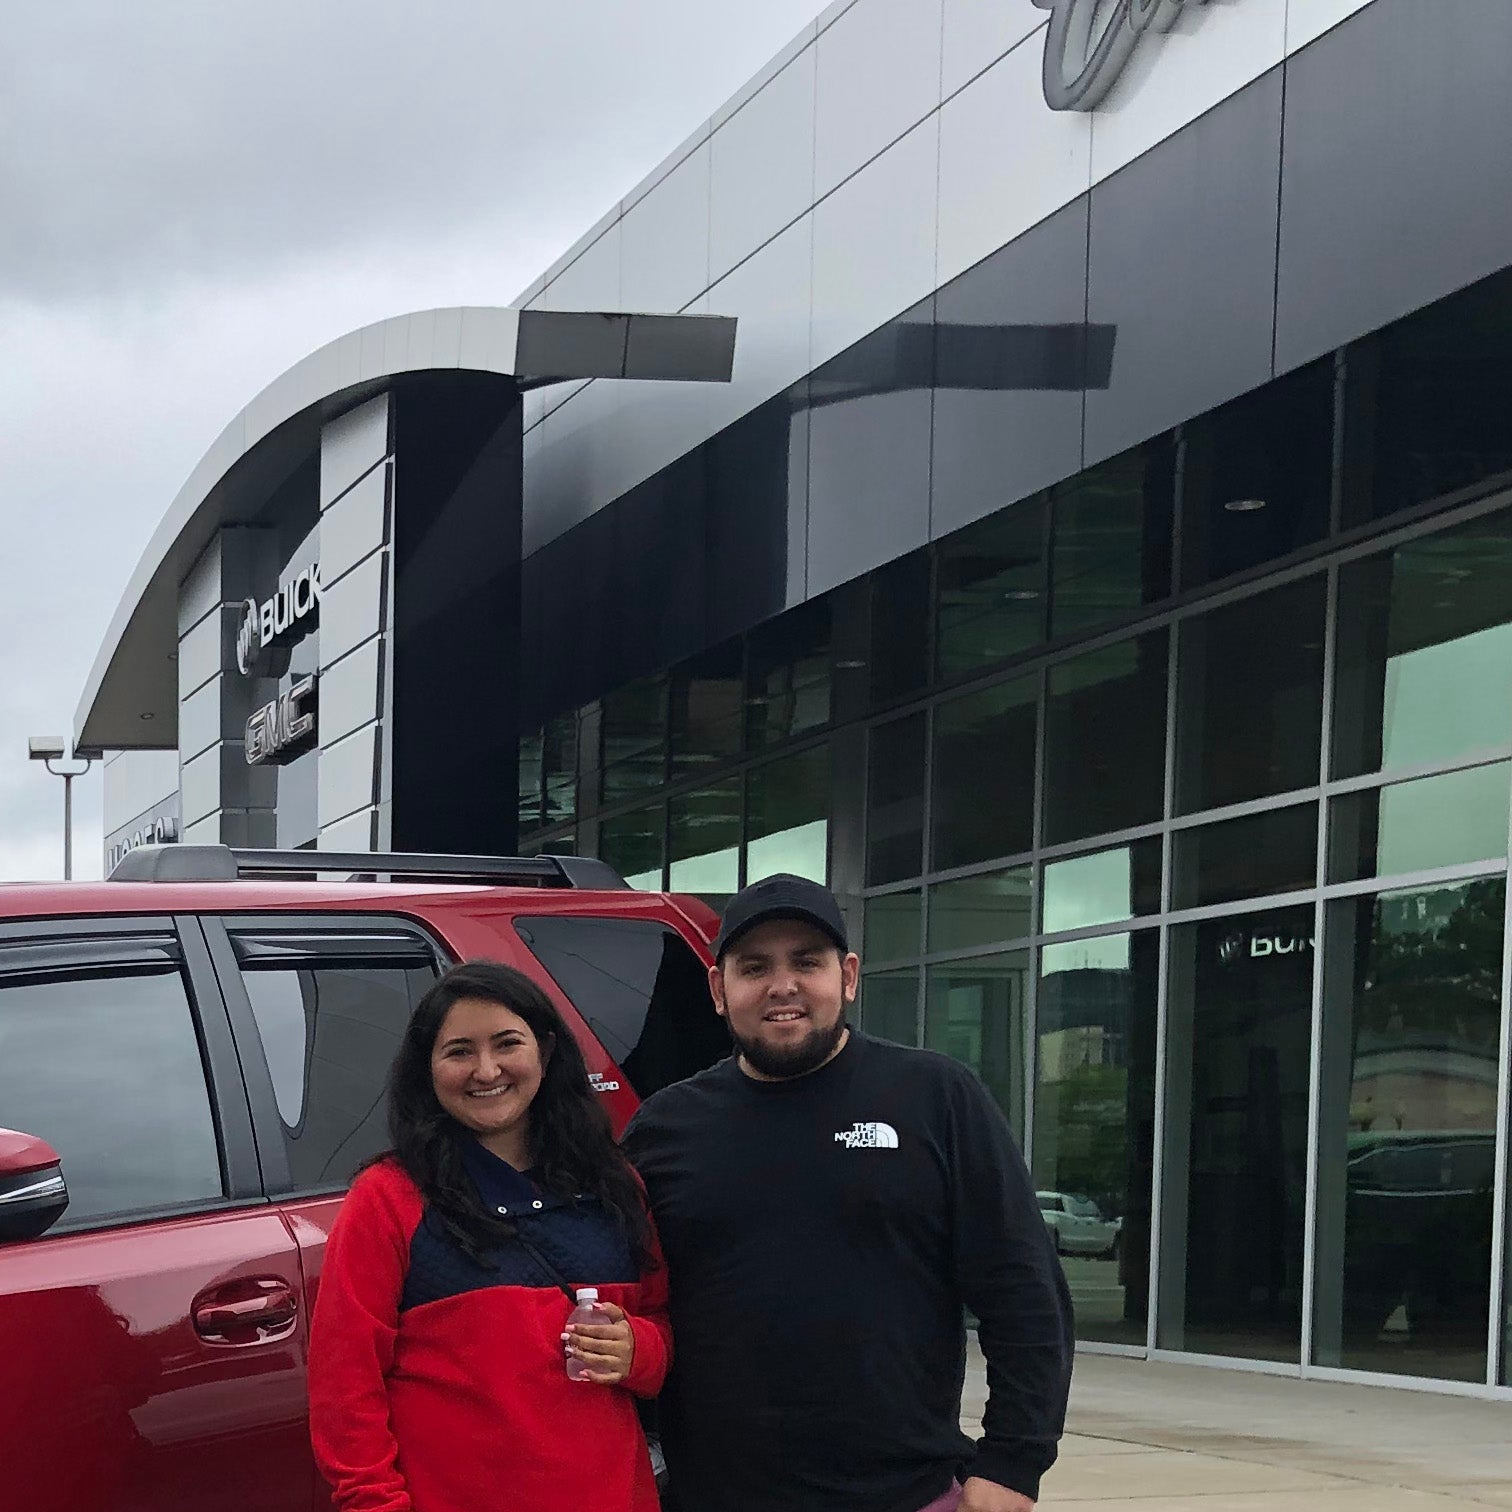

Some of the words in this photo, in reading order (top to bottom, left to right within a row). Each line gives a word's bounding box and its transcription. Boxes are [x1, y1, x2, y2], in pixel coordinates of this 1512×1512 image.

[261, 563, 320, 648] BUICK
[245, 674, 314, 765] GMC
[1250, 936, 1315, 957] BUI
[852, 1122, 876, 1132] THE
[834, 1130, 876, 1141] NORTH
[845, 1139, 876, 1149] FACE
